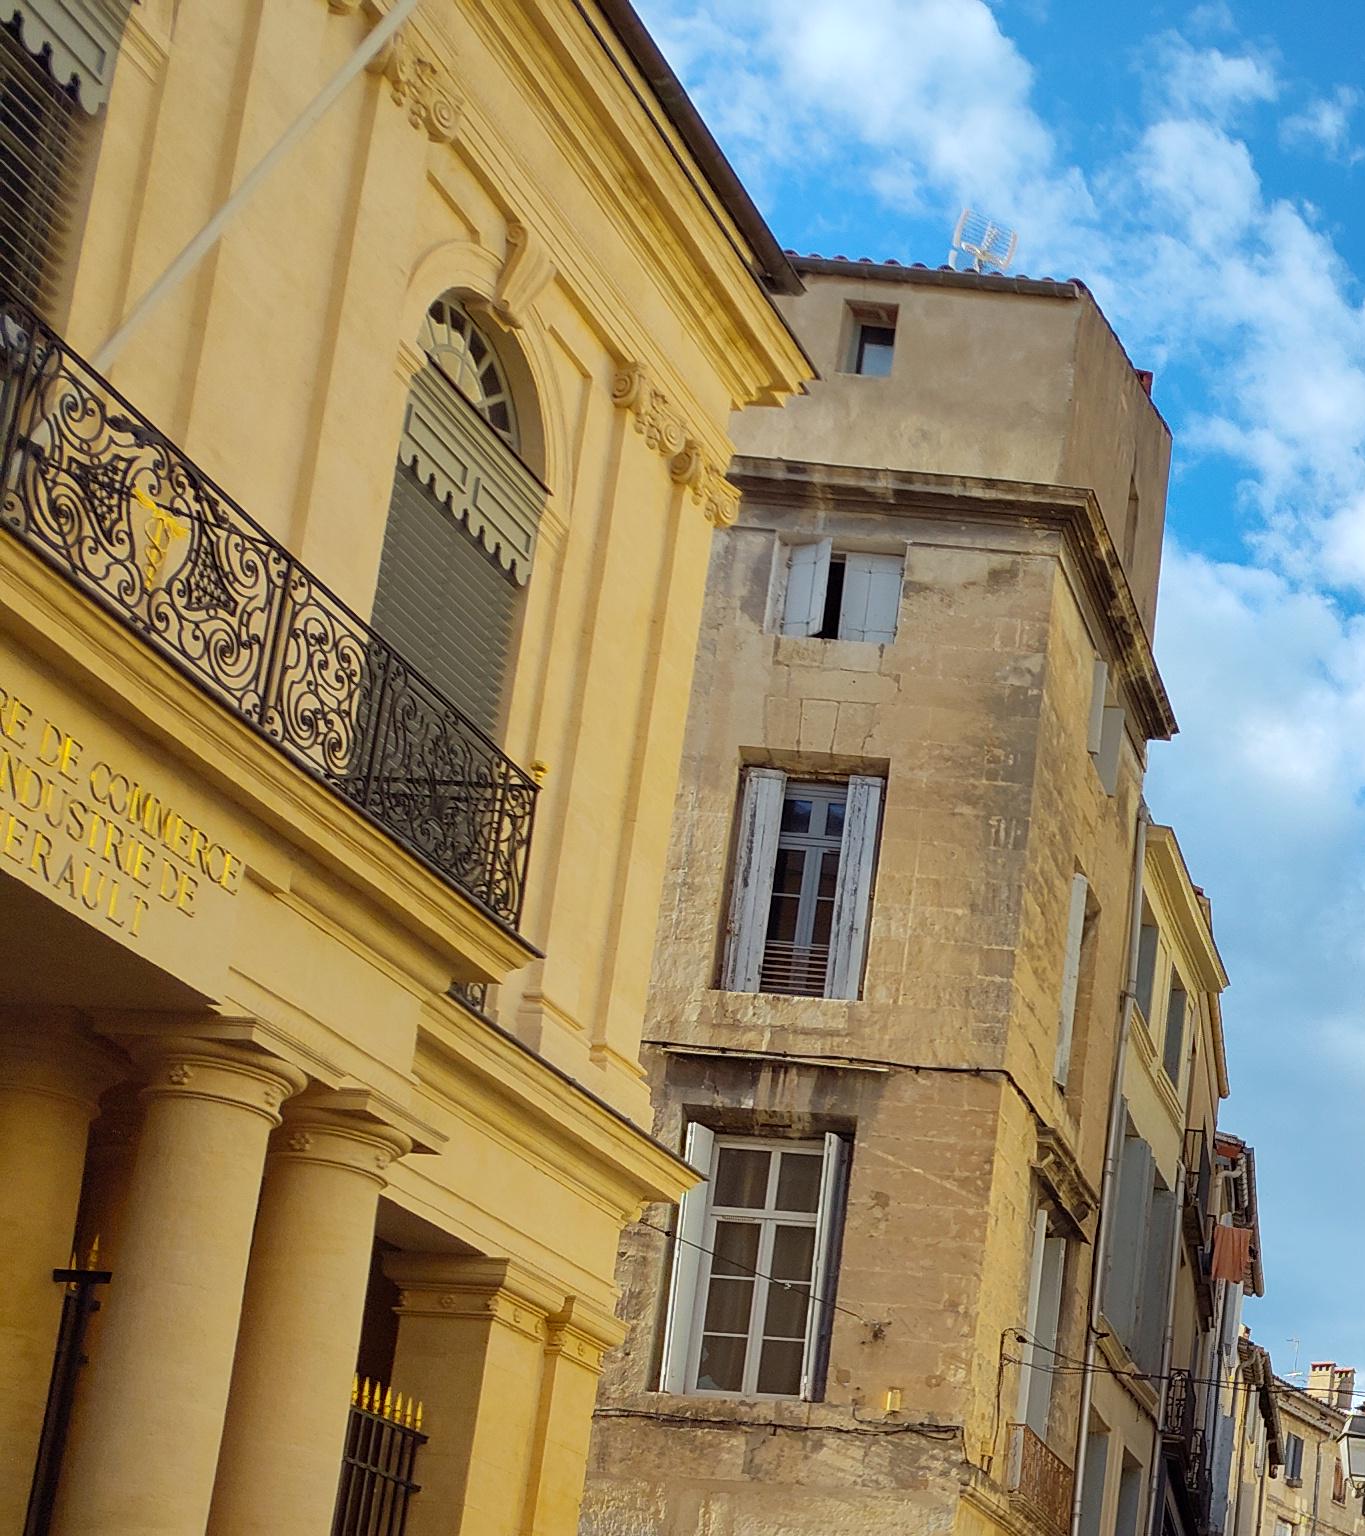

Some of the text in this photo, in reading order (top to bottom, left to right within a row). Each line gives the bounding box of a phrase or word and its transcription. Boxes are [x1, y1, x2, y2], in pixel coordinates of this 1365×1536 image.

[0, 805, 149, 938] ERAULT
[36, 718, 84, 785] DE
[89, 760, 242, 896] COMMERCE
[158, 857, 198, 918] DE
